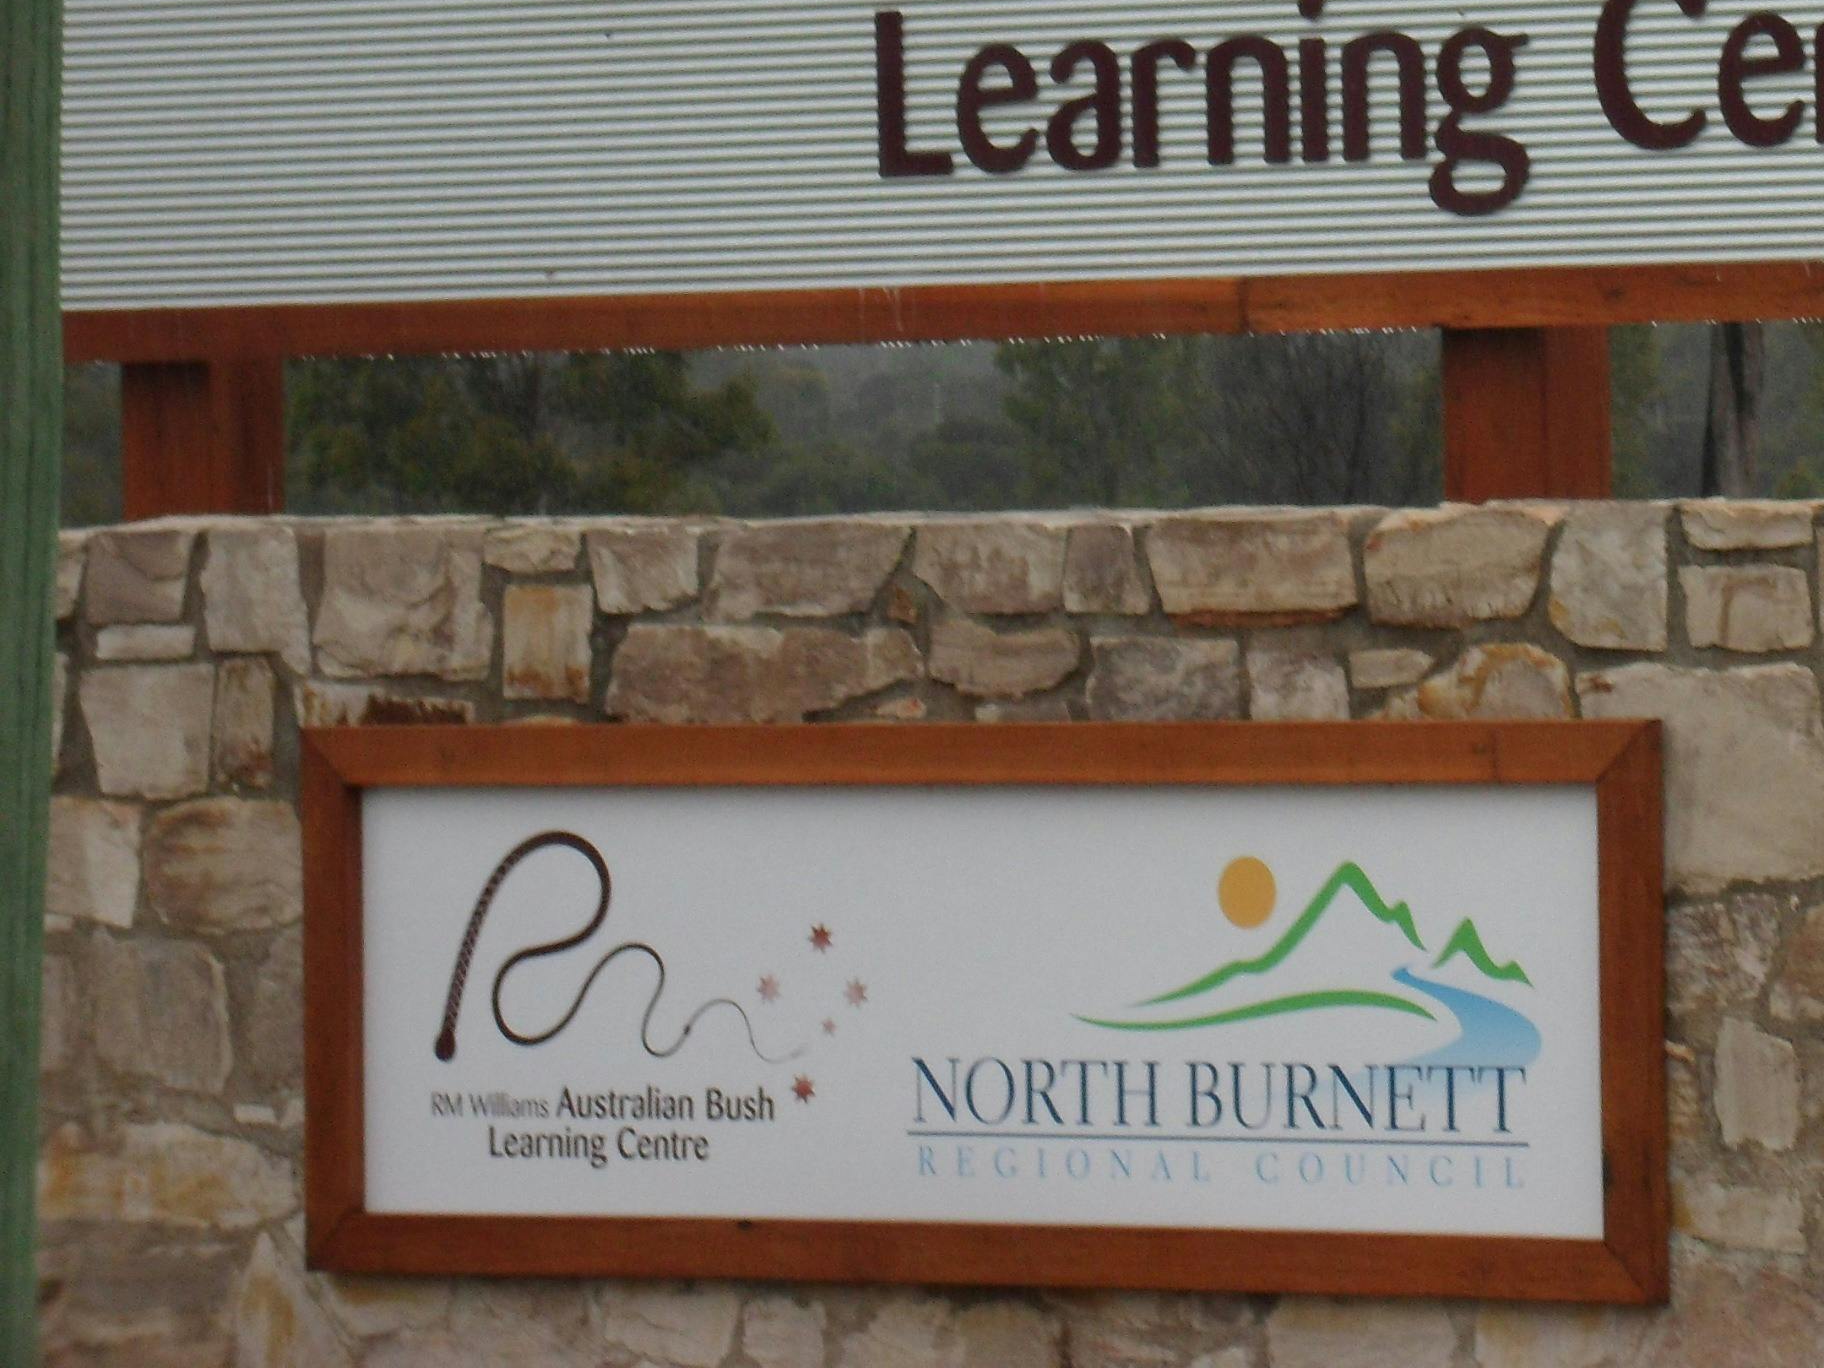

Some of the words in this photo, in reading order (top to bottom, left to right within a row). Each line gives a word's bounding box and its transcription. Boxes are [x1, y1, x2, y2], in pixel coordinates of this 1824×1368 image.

[430, 1091, 467, 1118] RM
[470, 1092, 549, 1120] Williams
[555, 1085, 695, 1121] Australian
[705, 1087, 776, 1122] Bush
[911, 1056, 1163, 1127] NORTH
[1189, 1062, 1528, 1135] BURNETT
[487, 1126, 609, 1168] Learning
[617, 1129, 711, 1164] Centre
[917, 1145, 1208, 1183] REGIONAL
[1255, 1153, 1527, 1188] COUNCIL
